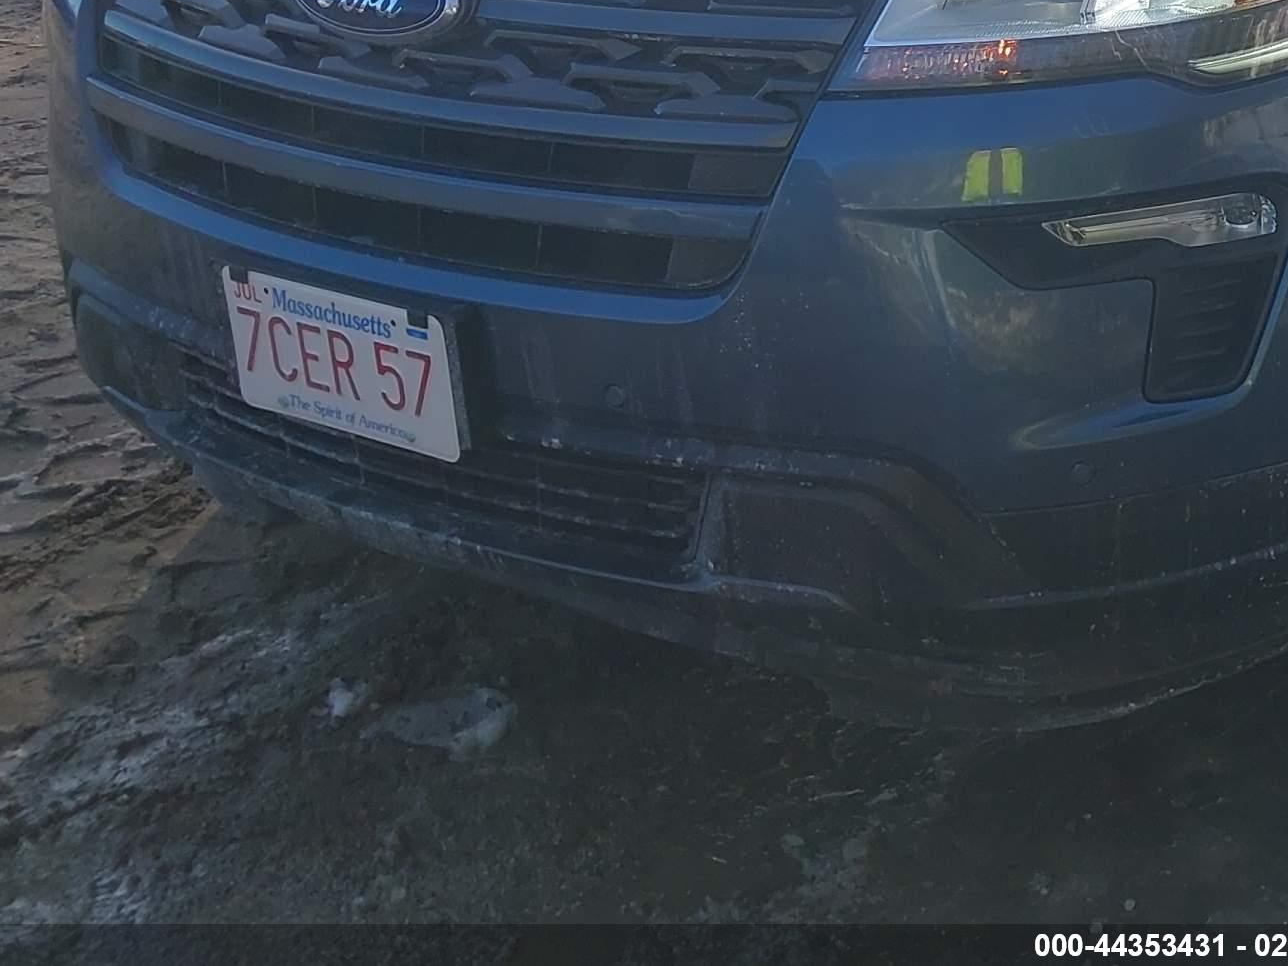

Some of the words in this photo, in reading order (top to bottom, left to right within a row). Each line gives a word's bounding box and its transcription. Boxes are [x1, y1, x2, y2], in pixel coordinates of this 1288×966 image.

[234, 282, 263, 304] JUL
[271, 286, 392, 340] Massachusetts
[236, 305, 361, 402] 7CER
[373, 341, 432, 418] 57
[289, 393, 311, 411] The
[313, 400, 342, 421] Spirit
[345, 411, 356, 425] of
[359, 414, 409, 440] America
